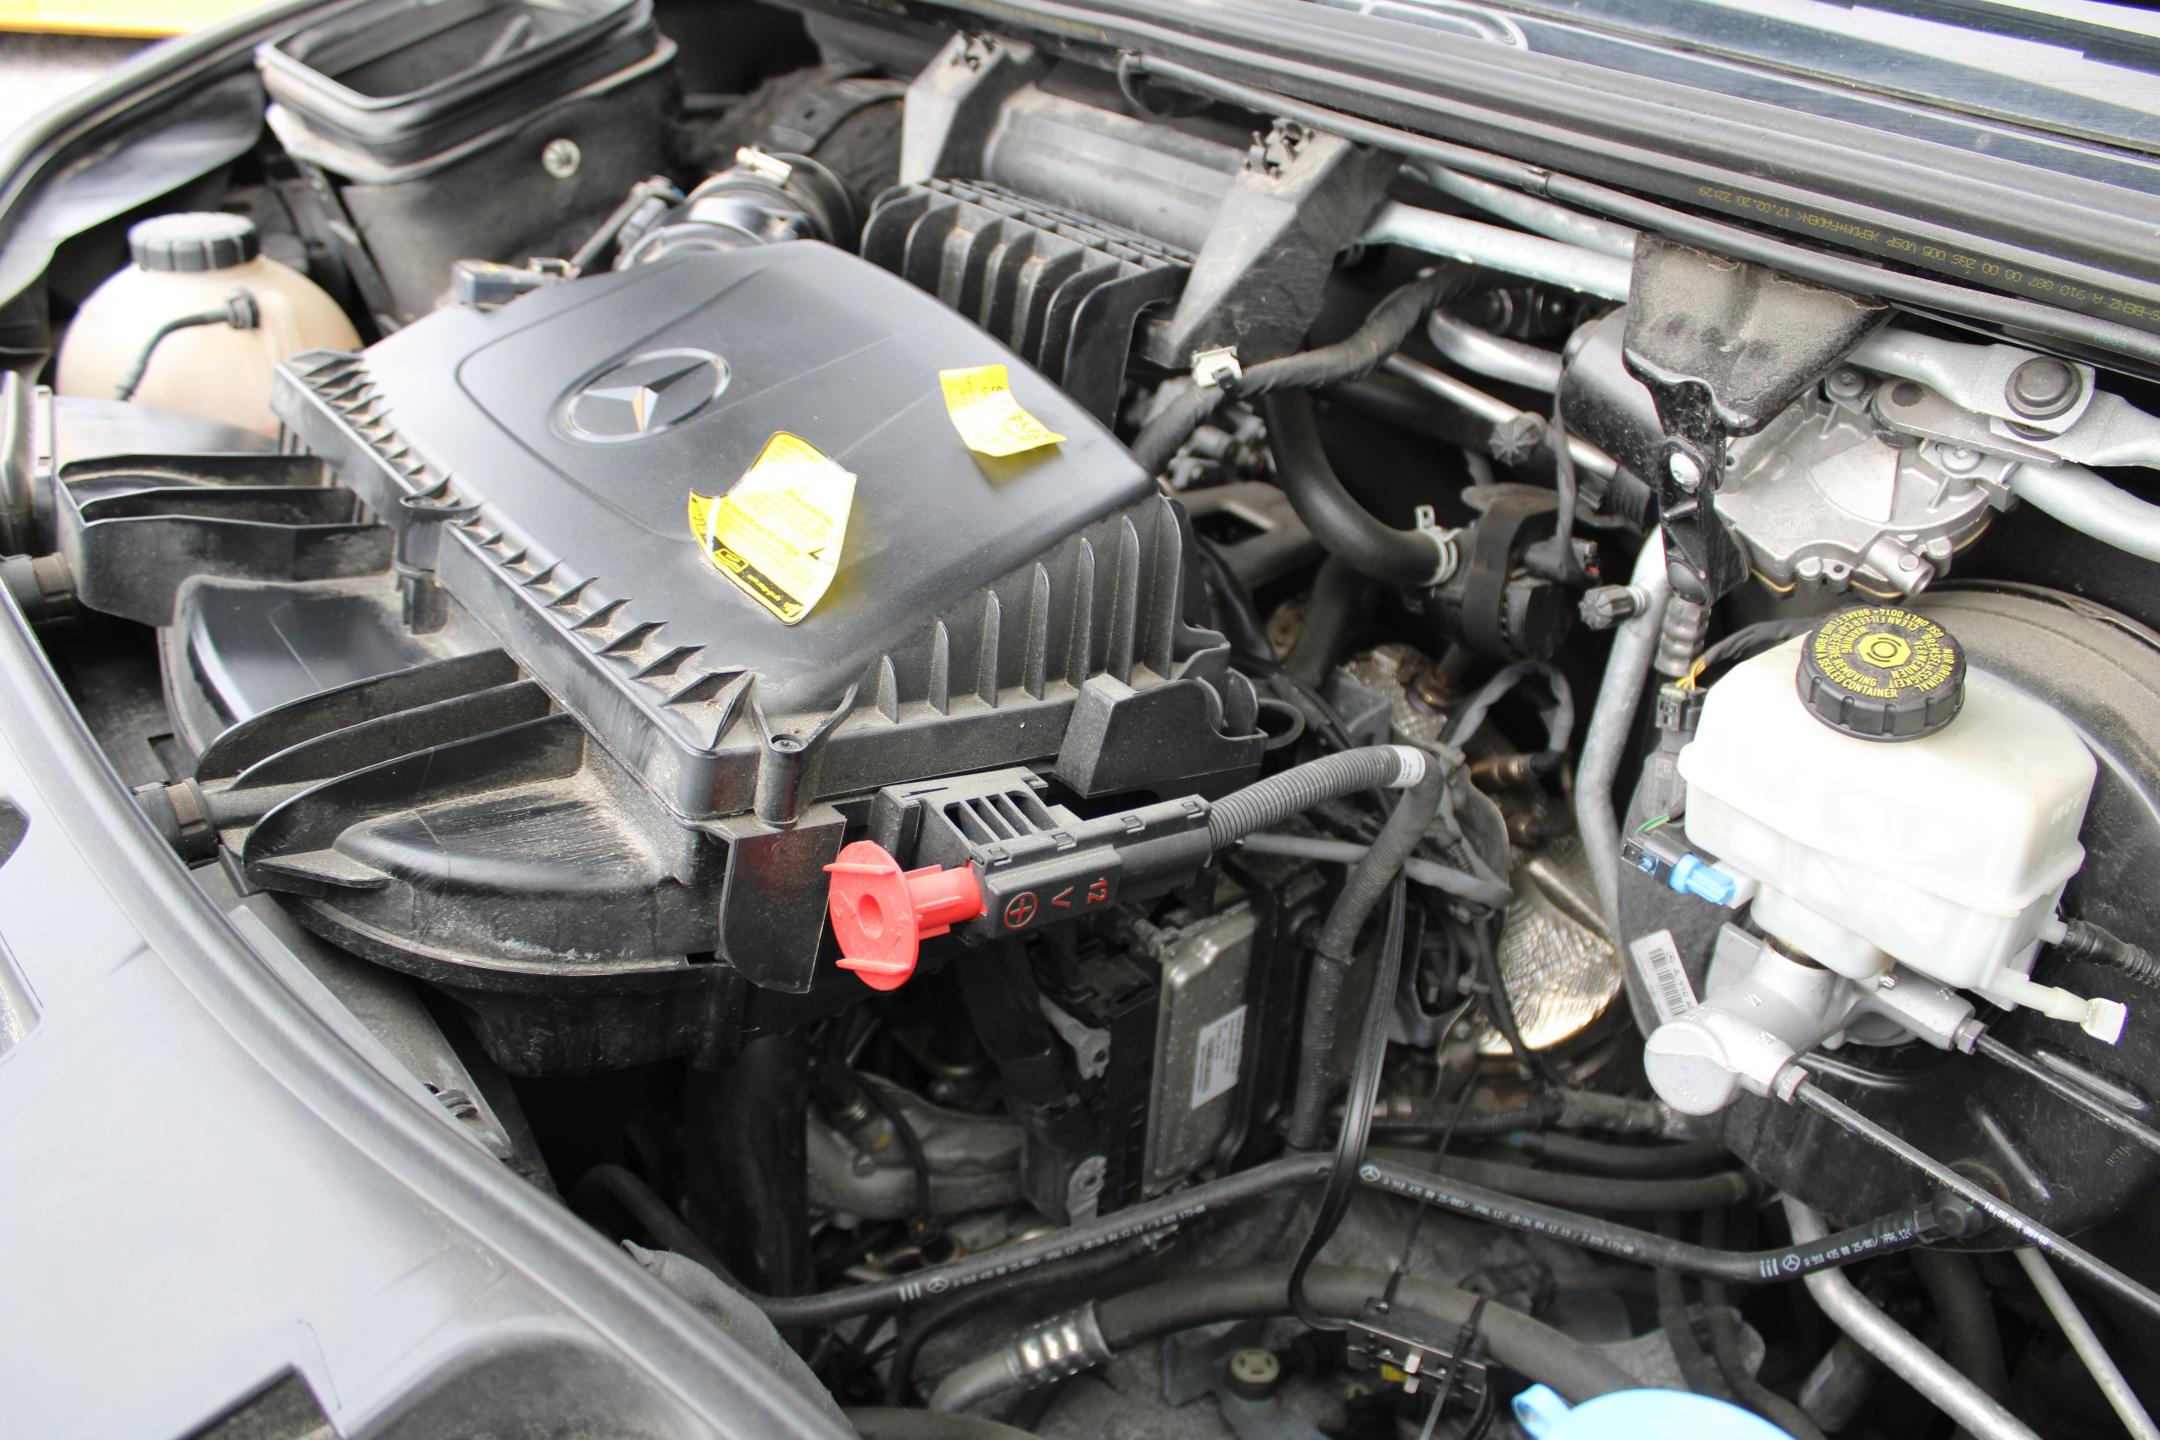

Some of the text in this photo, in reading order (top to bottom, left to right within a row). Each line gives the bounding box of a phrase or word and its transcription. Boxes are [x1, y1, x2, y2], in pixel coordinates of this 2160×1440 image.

[1982, 262, 2000, 276] 00
[2005, 269, 2023, 282] 00
[2060, 284, 2086, 301] 910
[2092, 293, 2104, 305] A
[1840, 608, 1871, 622] BRAKE
[1851, 615, 1886, 627] FILLER
[1905, 613, 1929, 627] ONLY
[1821, 618, 1844, 635] FLUID
[1888, 617, 1920, 631] CLEAN
[1927, 624, 1945, 638] USE
[1815, 634, 1829, 652] FROM
[1840, 625, 1869, 654] WARNING
[1890, 640, 1929, 679] VERWENDEN
[1817, 657, 1845, 684] SEALED
[1832, 657, 1879, 687] REMOVING
[1914, 648, 1955, 692] NUR ORIGINAL
[1842, 679, 1899, 698] CONTAINER
[1087, 877, 1109, 905] 12
